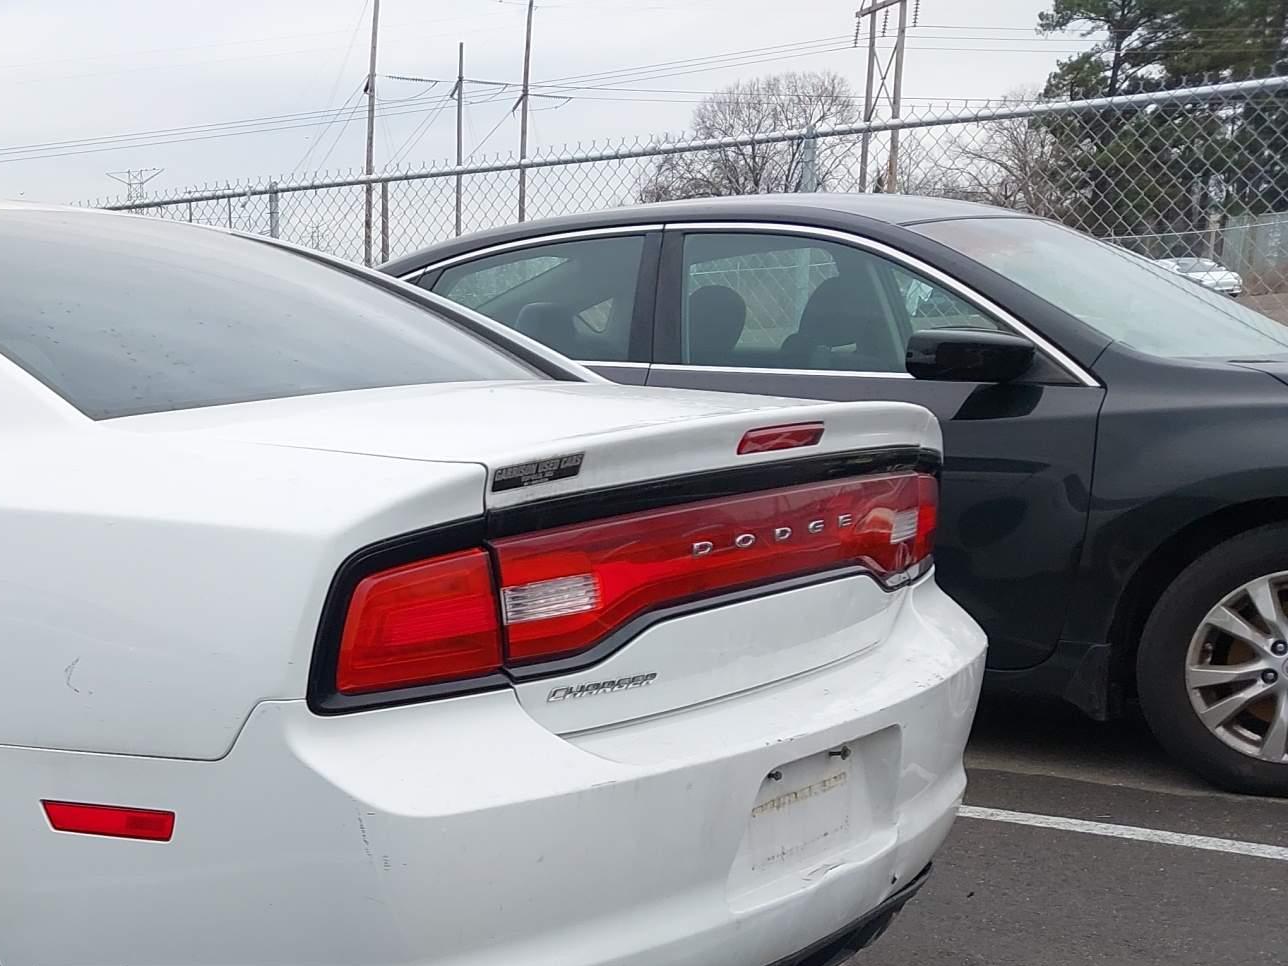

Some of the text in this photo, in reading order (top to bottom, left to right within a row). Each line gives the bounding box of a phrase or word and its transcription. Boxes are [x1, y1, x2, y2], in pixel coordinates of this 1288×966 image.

[537, 460, 560, 473] USED
[560, 456, 582, 468] CARS
[691, 513, 853, 556] DODGE
[548, 672, 657, 702] CHARGER
